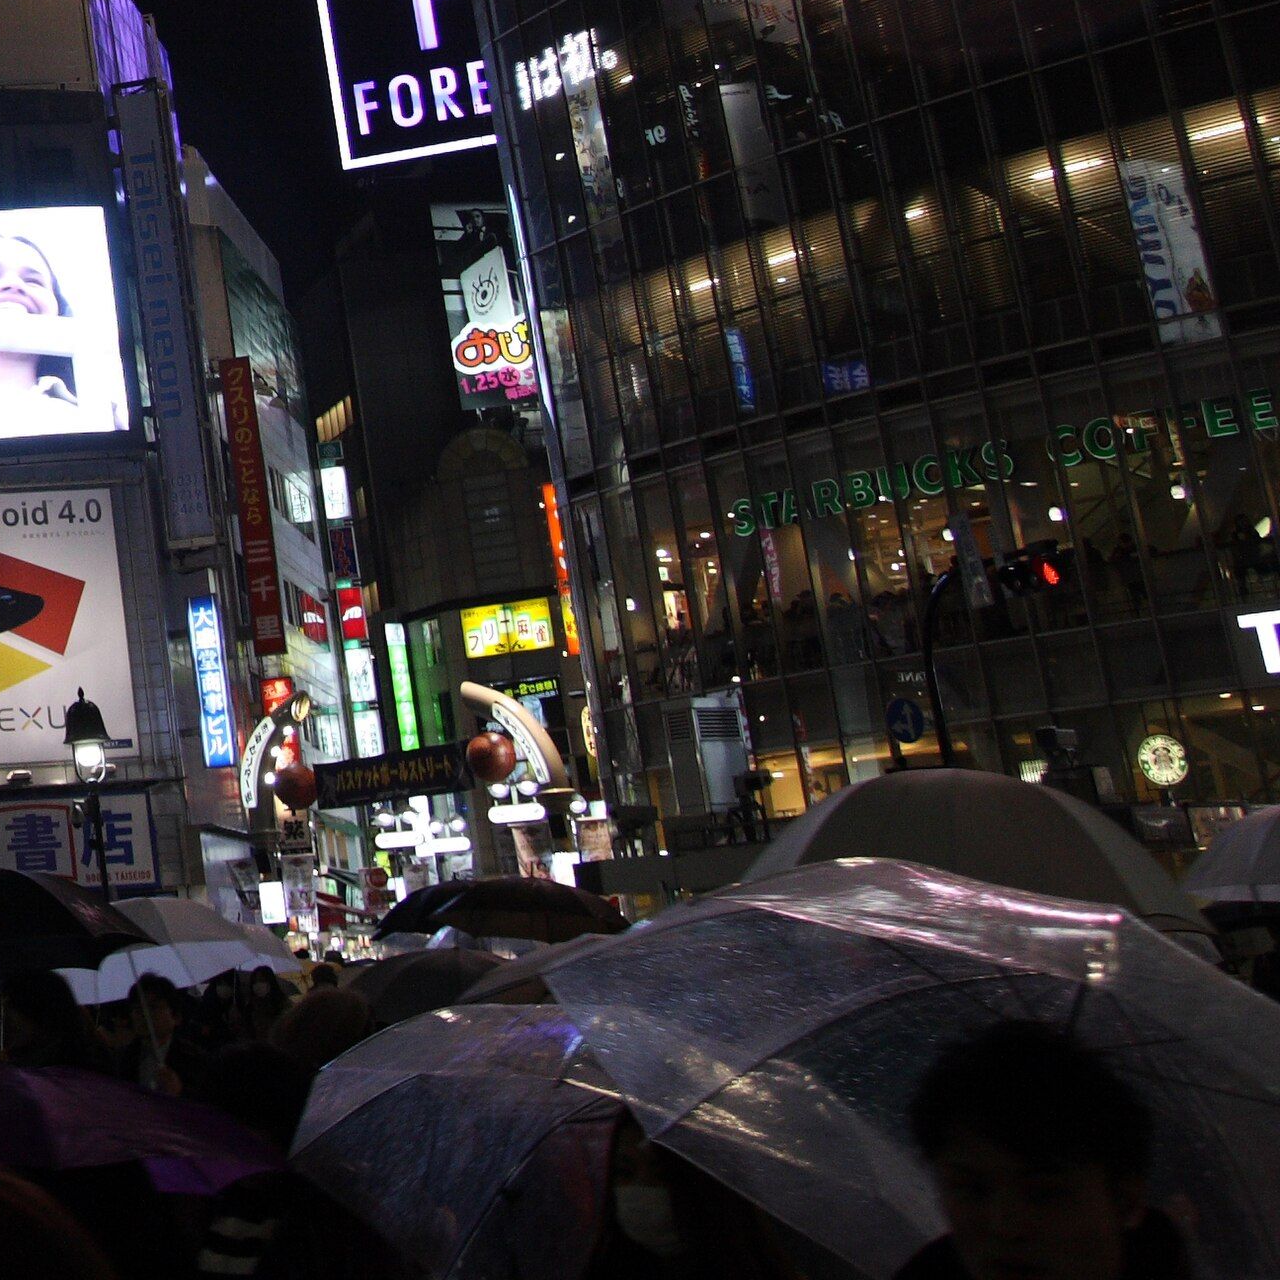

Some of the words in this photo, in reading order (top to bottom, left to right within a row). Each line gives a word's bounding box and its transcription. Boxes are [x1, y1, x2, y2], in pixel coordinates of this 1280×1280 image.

[57, 497, 103, 524] 4.0
[732, 439, 1015, 538] STARBUCKS
[245, 539, 282, 641] 三千里
